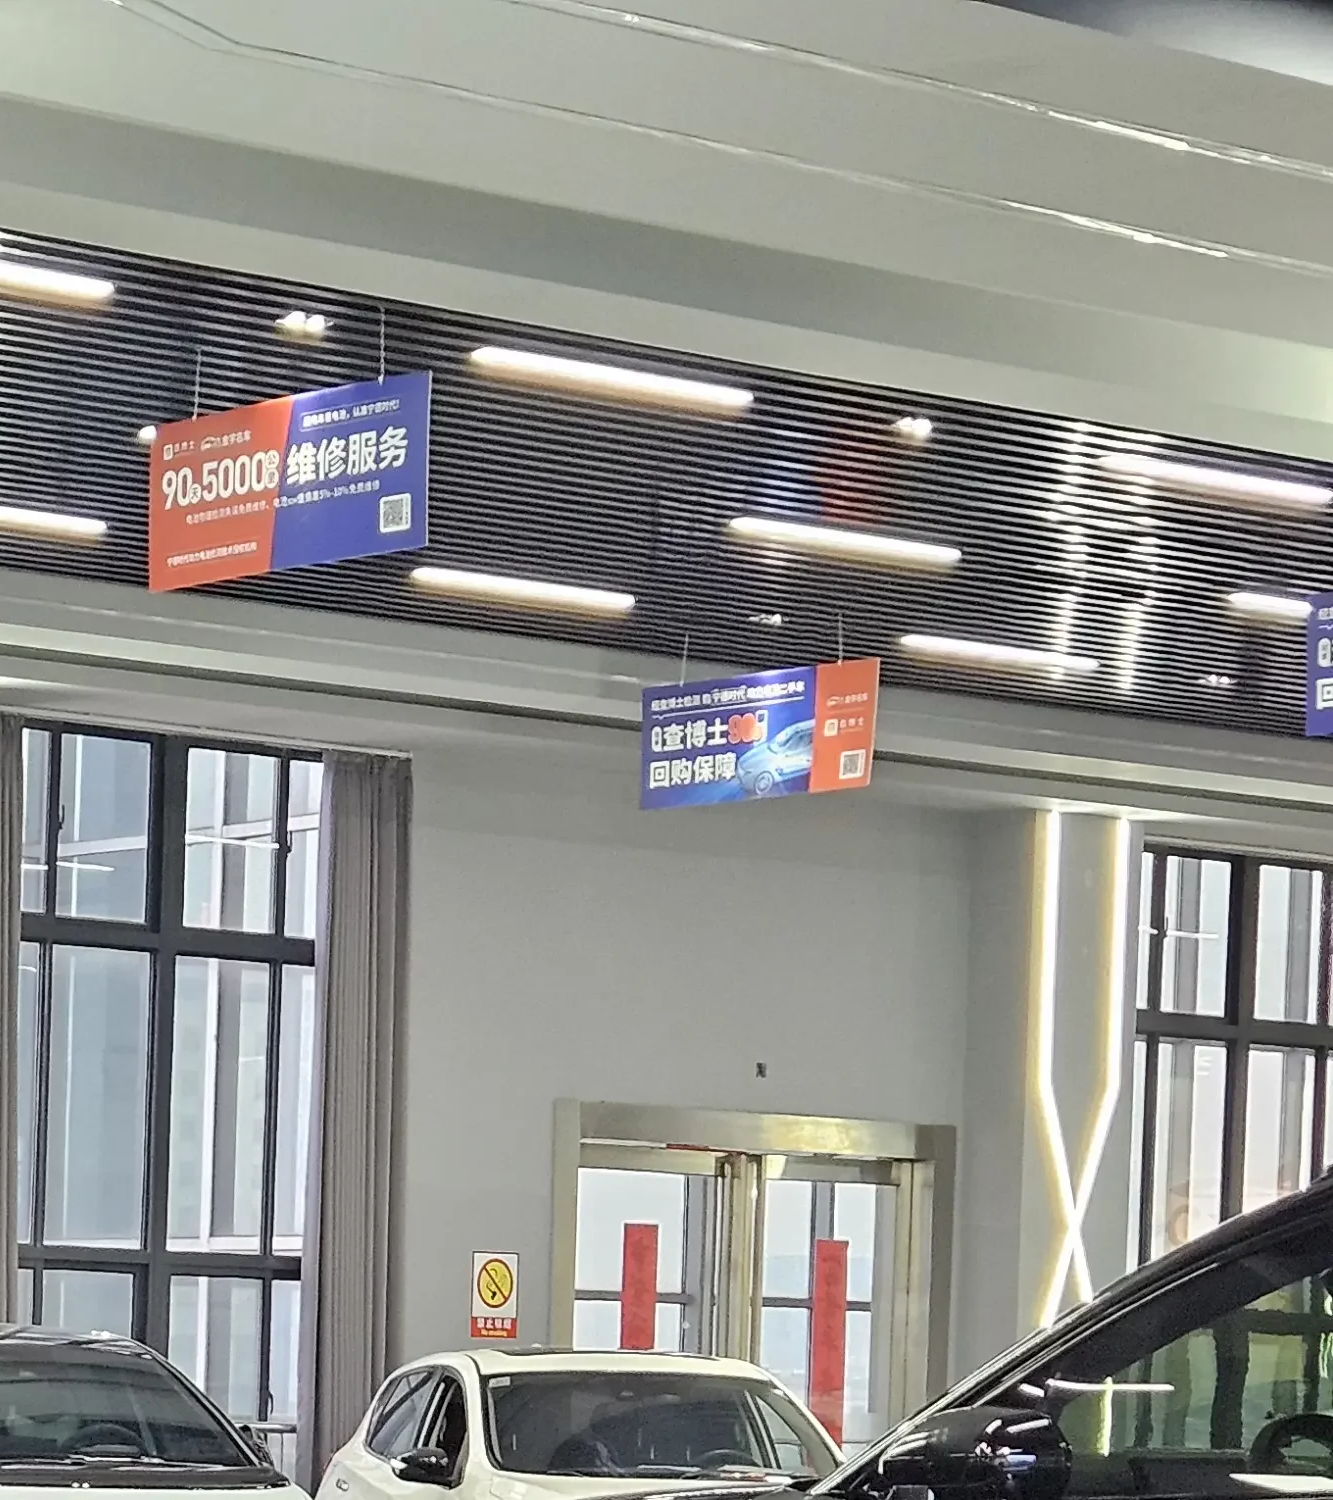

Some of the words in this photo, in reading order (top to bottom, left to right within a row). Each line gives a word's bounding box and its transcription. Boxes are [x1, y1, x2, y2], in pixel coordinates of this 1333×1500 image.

[285, 425, 408, 486] 维修服务
[649, 752, 738, 789] 回购保障
